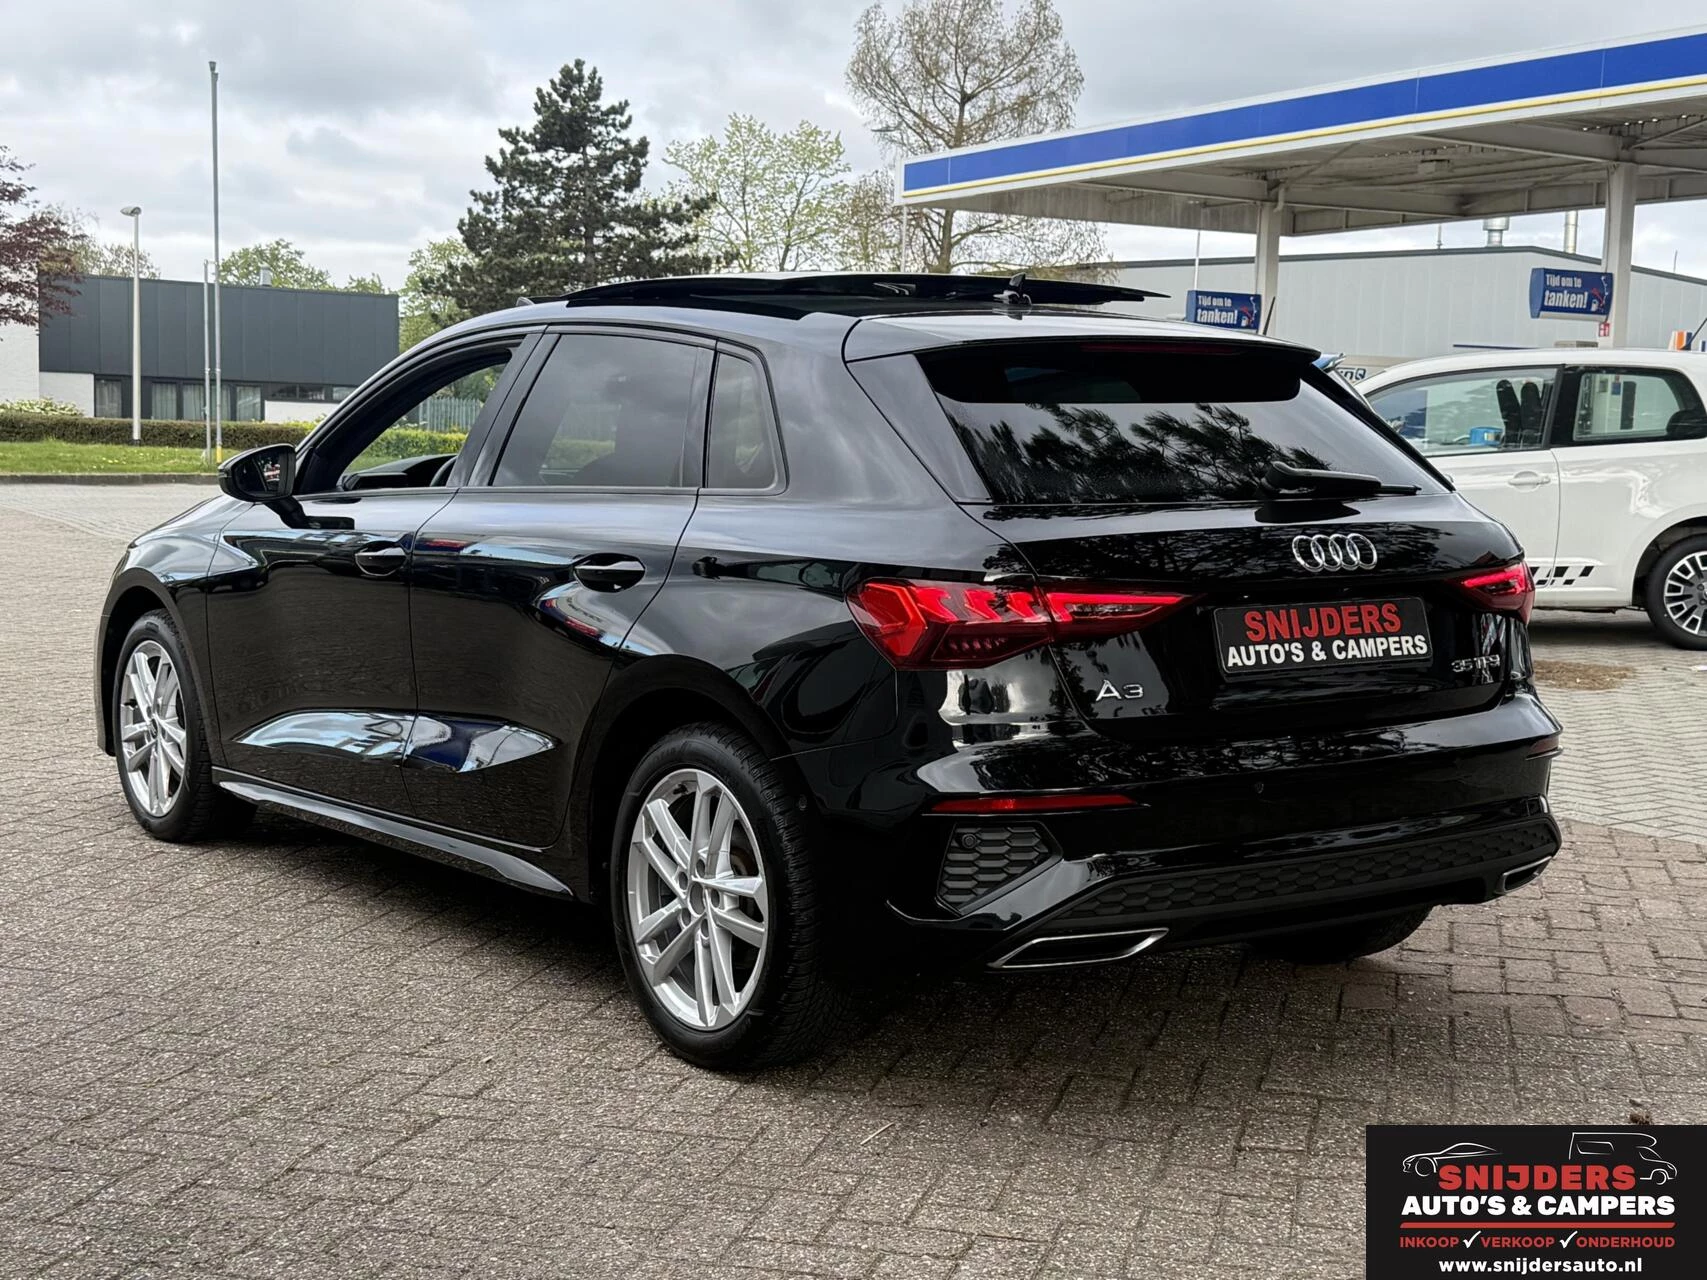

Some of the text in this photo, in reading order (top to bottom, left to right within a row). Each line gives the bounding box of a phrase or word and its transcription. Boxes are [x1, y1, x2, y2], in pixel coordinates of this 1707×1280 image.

[1546, 274, 1582, 288] Tijd om te
[1198, 295, 1232, 307] Tijd om te
[1544, 290, 1588, 309] tanken!
[1197, 308, 1238, 324] tanken!
[1244, 603, 1402, 642] SNIJDERS
[1227, 635, 1428, 667] AUTO'S & CAMPERS
[1095, 679, 1143, 701] A3
